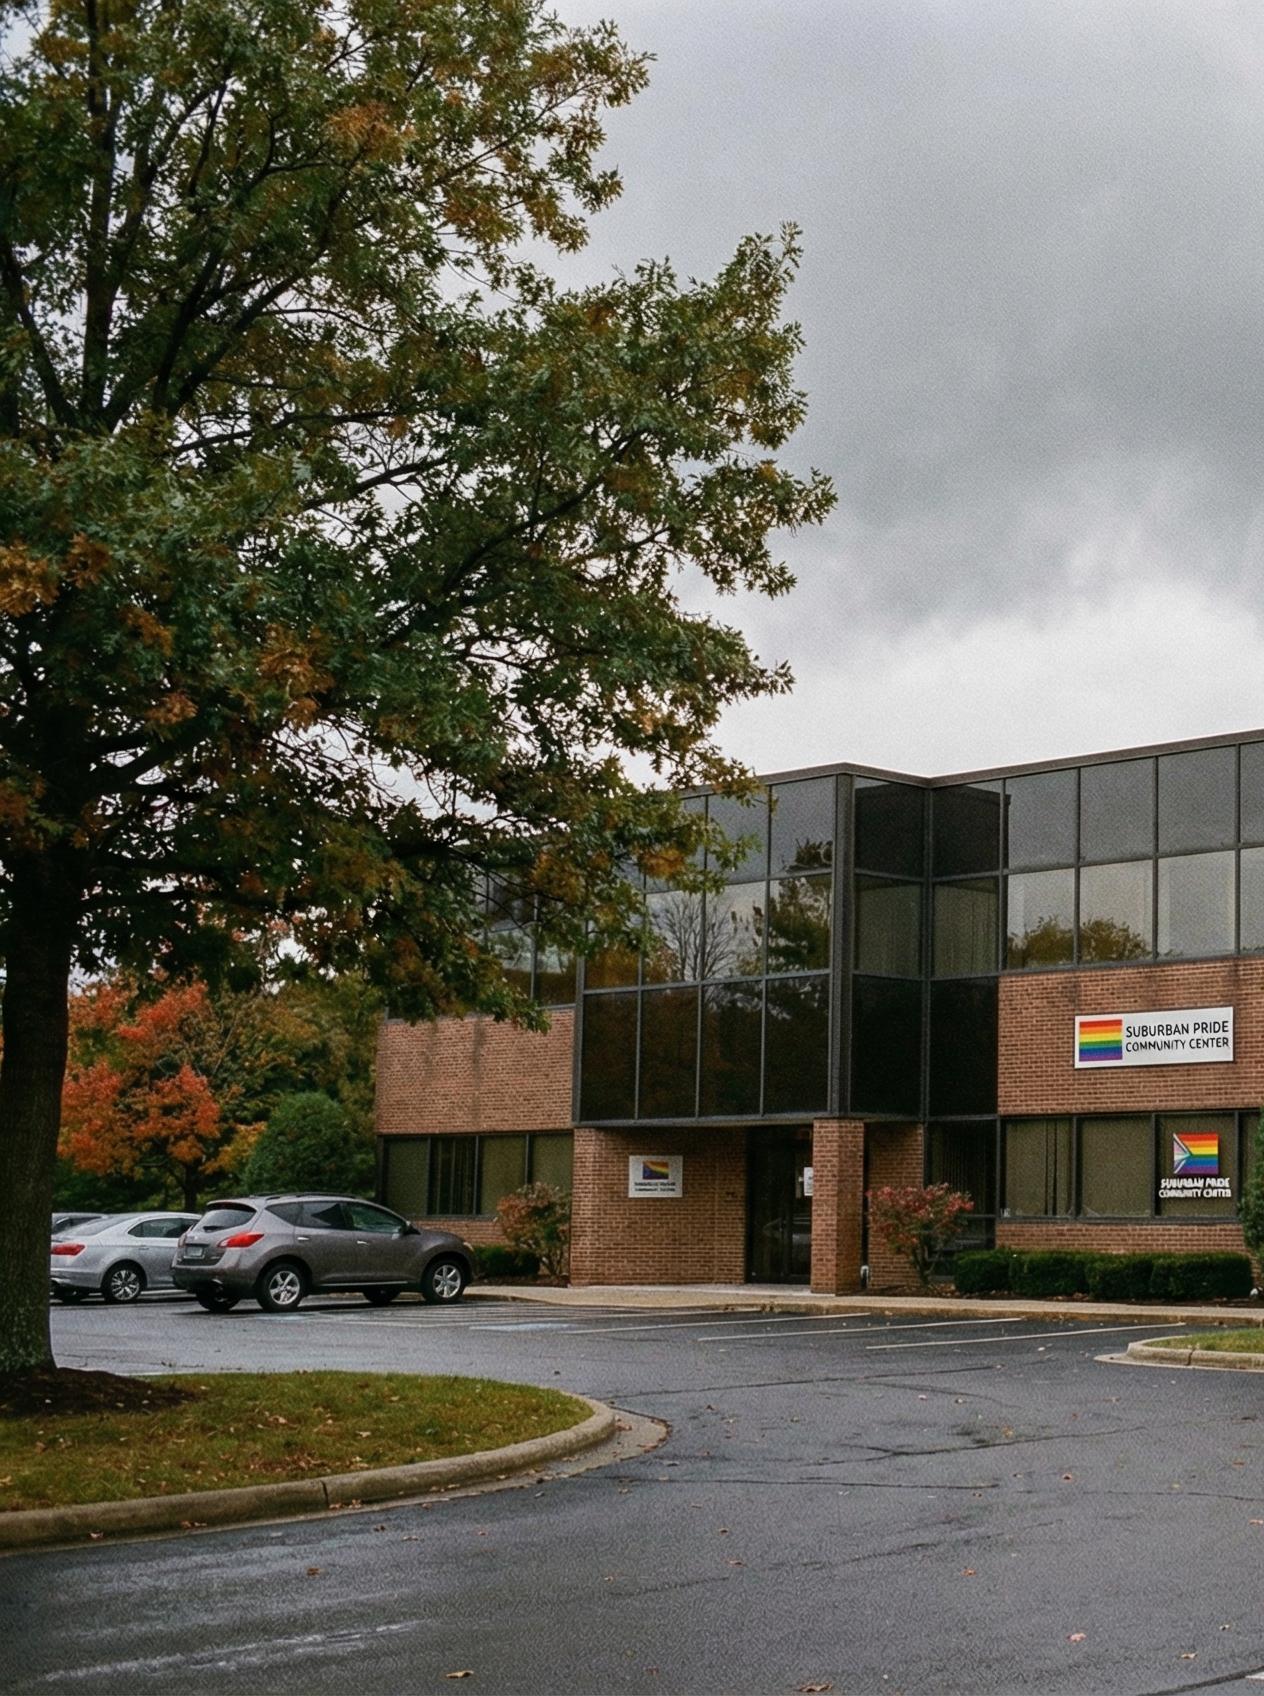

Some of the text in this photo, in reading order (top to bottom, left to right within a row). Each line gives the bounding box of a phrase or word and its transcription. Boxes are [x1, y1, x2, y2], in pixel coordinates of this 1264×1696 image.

[1126, 1020, 1230, 1038] SUBURBAN PRIDE
[1125, 1037, 1230, 1053] COMMUNITY CENTER
